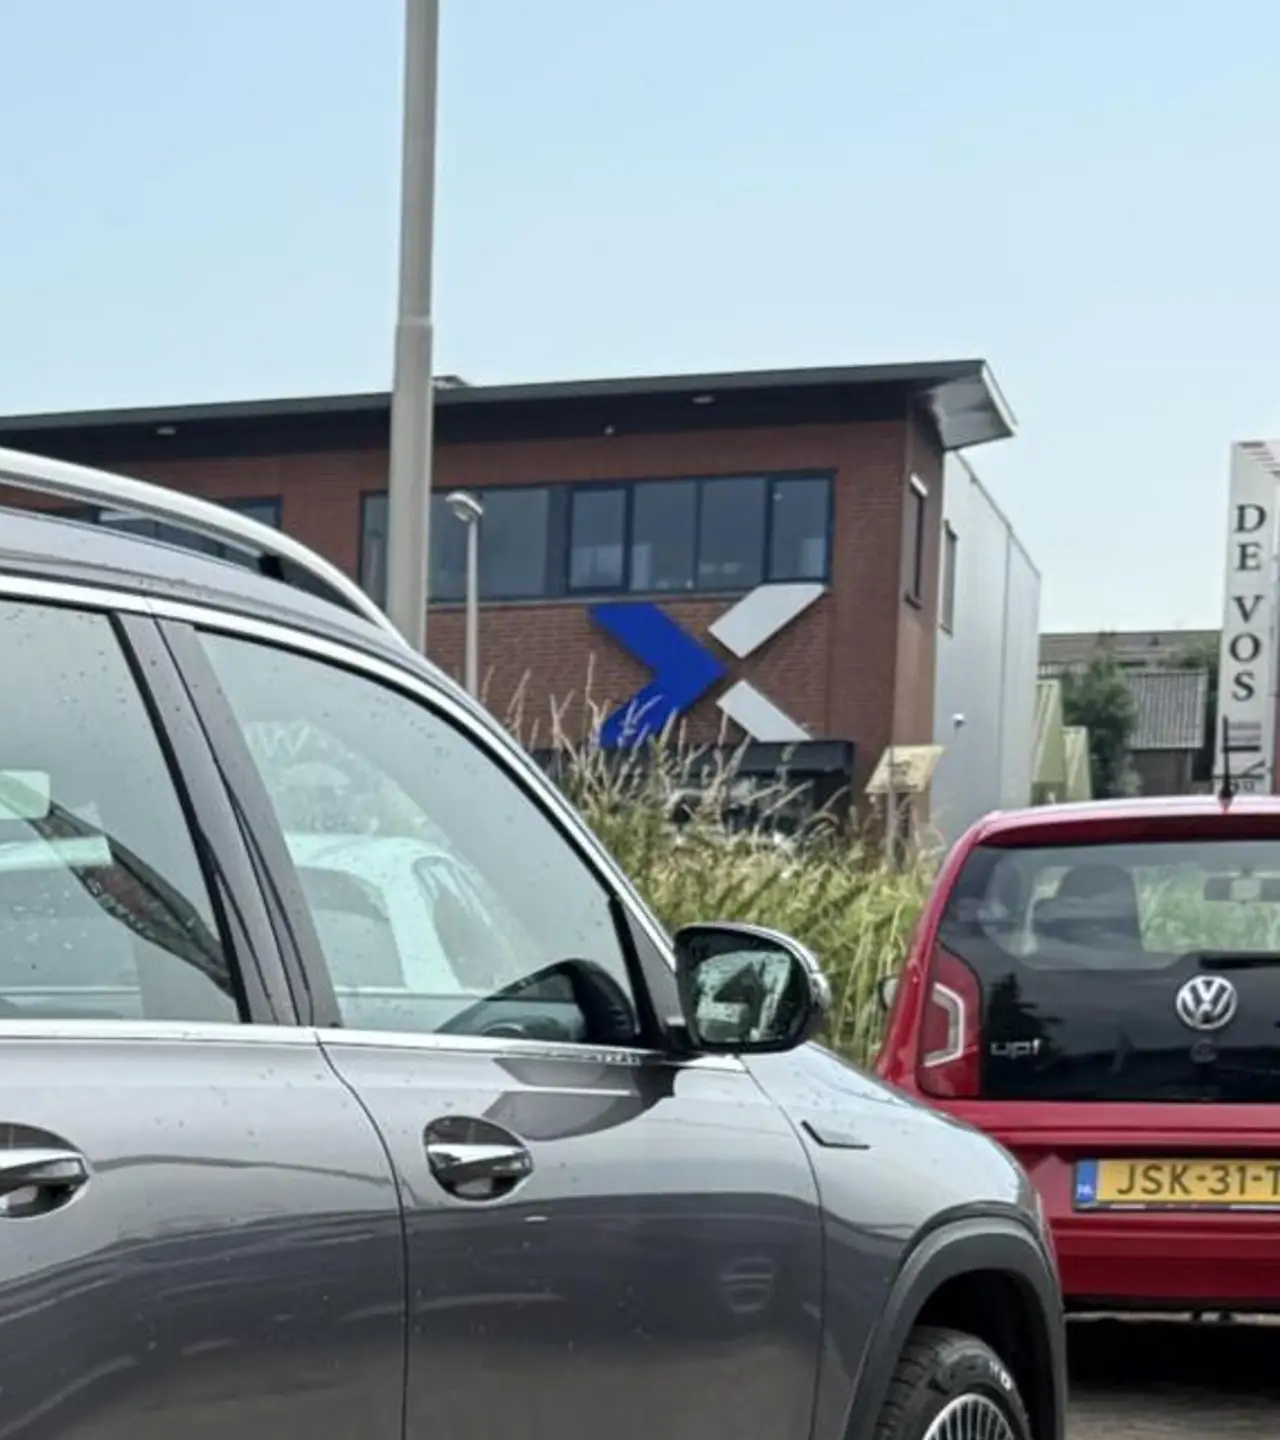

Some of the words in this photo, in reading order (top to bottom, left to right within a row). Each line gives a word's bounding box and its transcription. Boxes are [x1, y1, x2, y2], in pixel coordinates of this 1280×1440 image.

[1235, 503, 1267, 571] DE
[1229, 594, 1264, 702] VOS
[1117, 1164, 1280, 1196] JSK-31-T
